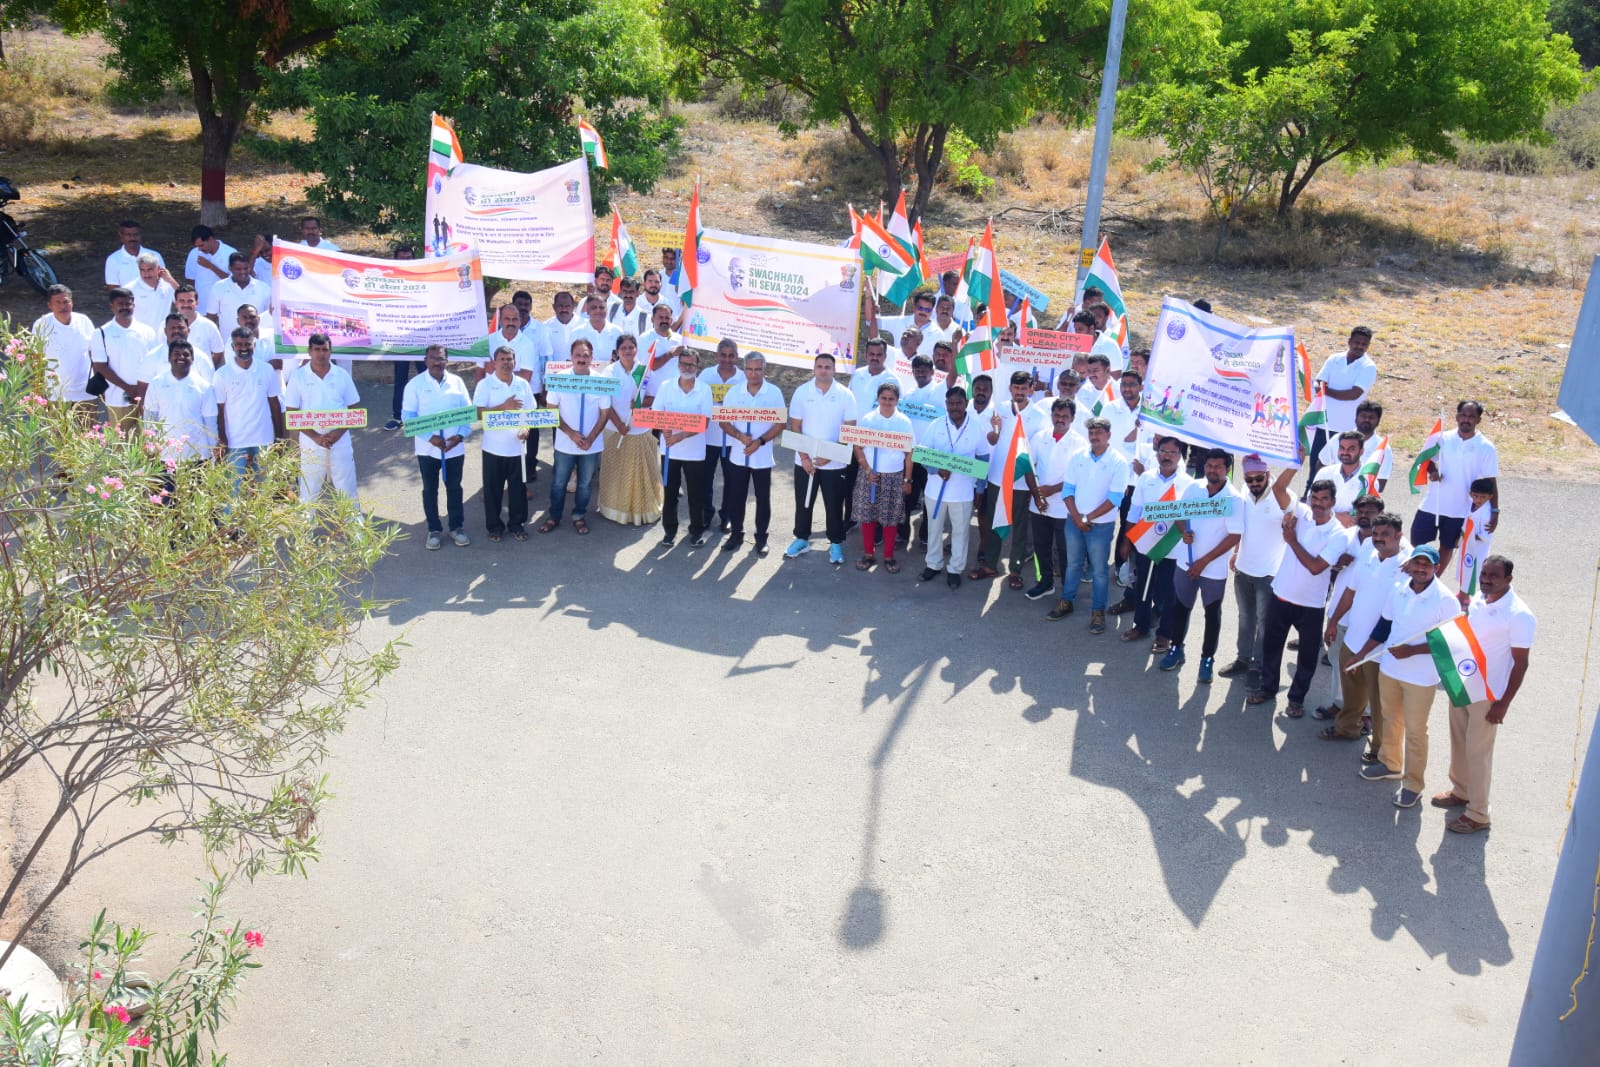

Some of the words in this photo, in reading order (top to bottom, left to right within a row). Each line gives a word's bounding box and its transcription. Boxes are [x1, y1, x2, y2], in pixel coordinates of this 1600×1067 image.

[748, 267, 804, 285] SWACHHATA
[748, 278, 757, 288] HI
[760, 280, 782, 292] SEVA
[784, 284, 809, 296] 2024
[1027, 331, 1056, 339] GREEN
[1027, 338, 1057, 347] CLEAN
[488, 411, 520, 421] सुरक्षित
[851, 428, 875, 437] COUNTRY
